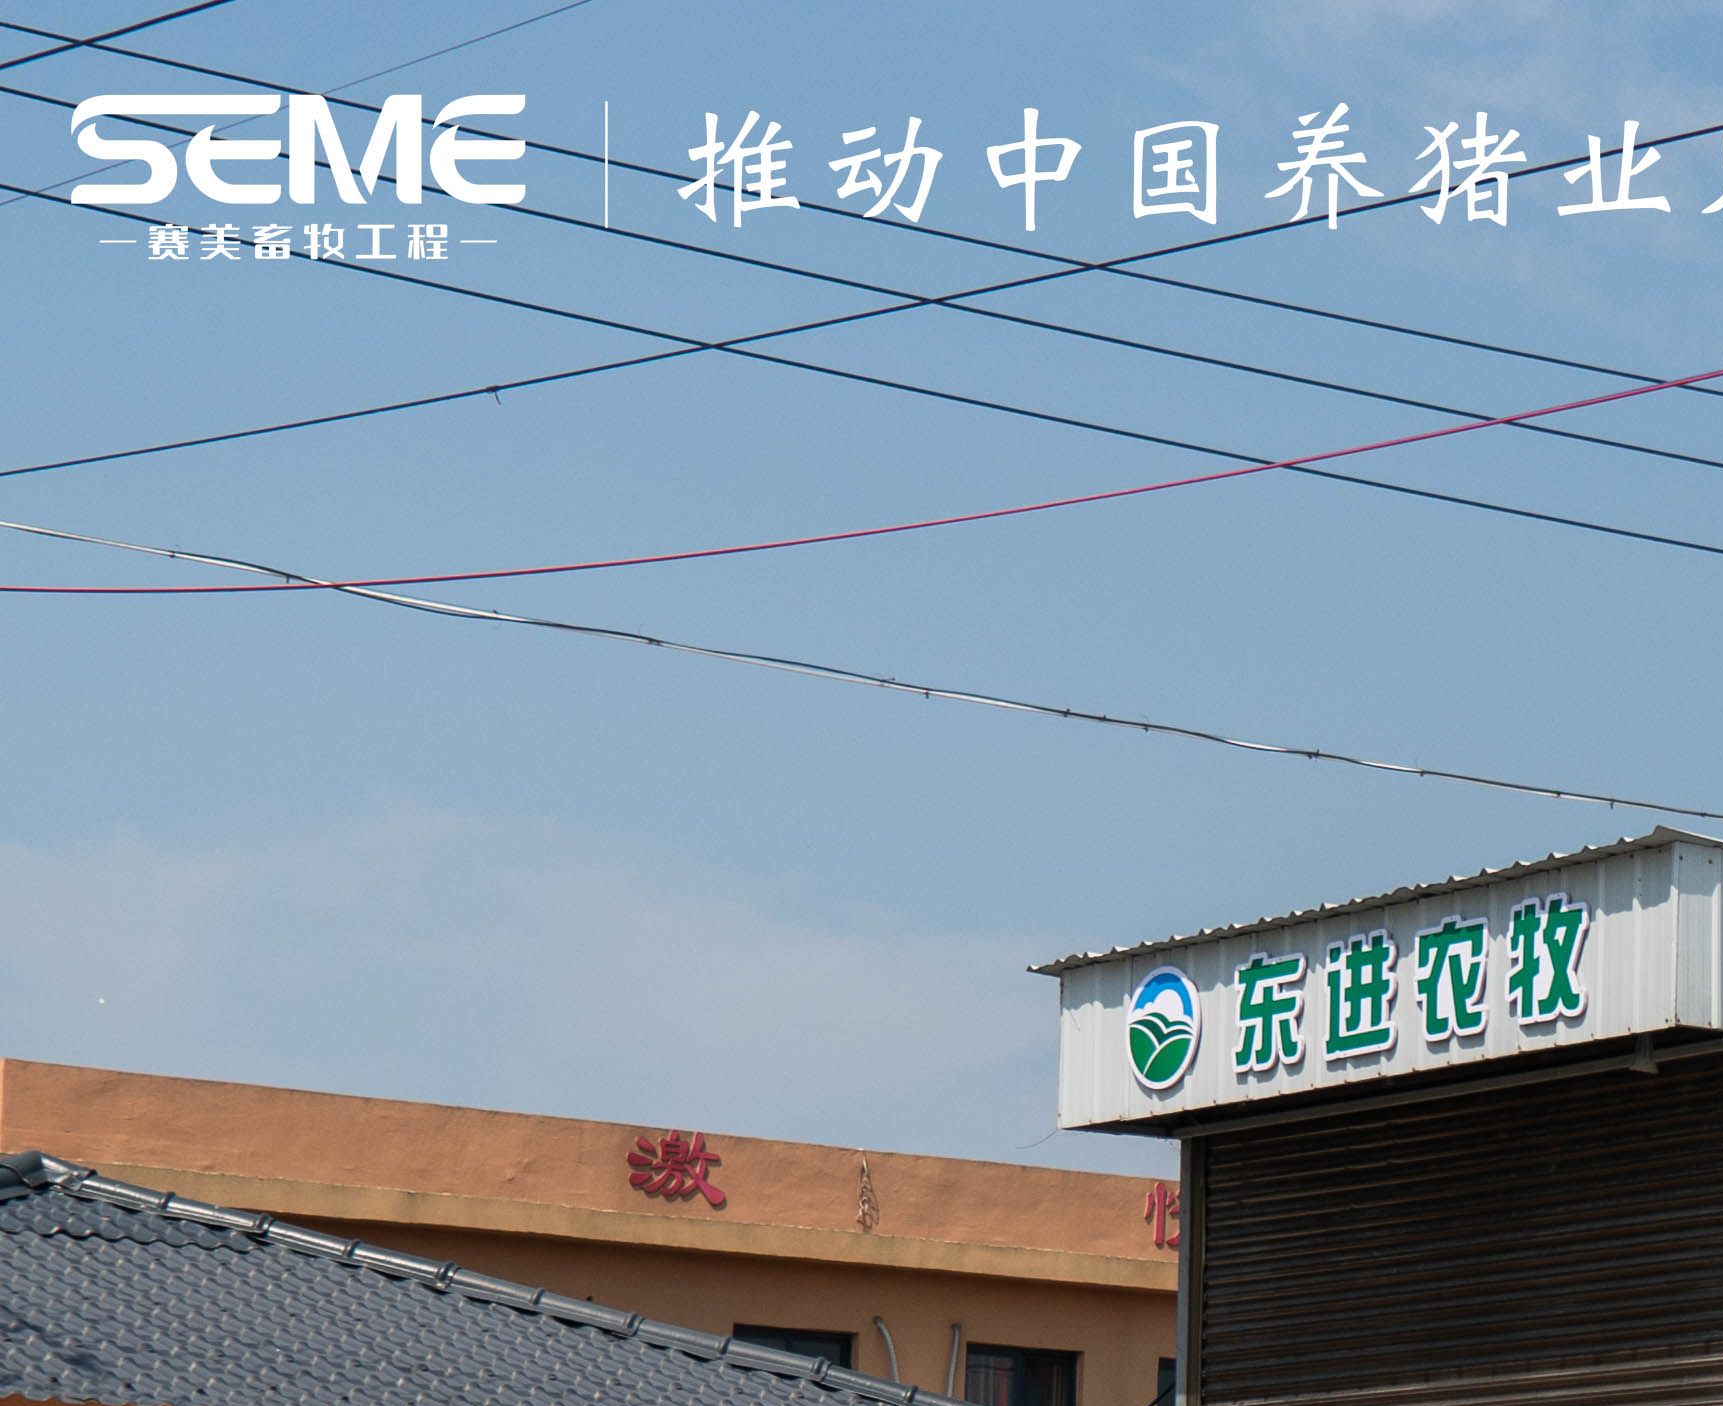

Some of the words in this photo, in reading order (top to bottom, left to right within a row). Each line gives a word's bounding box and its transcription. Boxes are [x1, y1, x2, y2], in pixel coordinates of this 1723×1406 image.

[1232, 899, 1585, 1069] 东进农牧
[627, 1131, 726, 1206] 激
